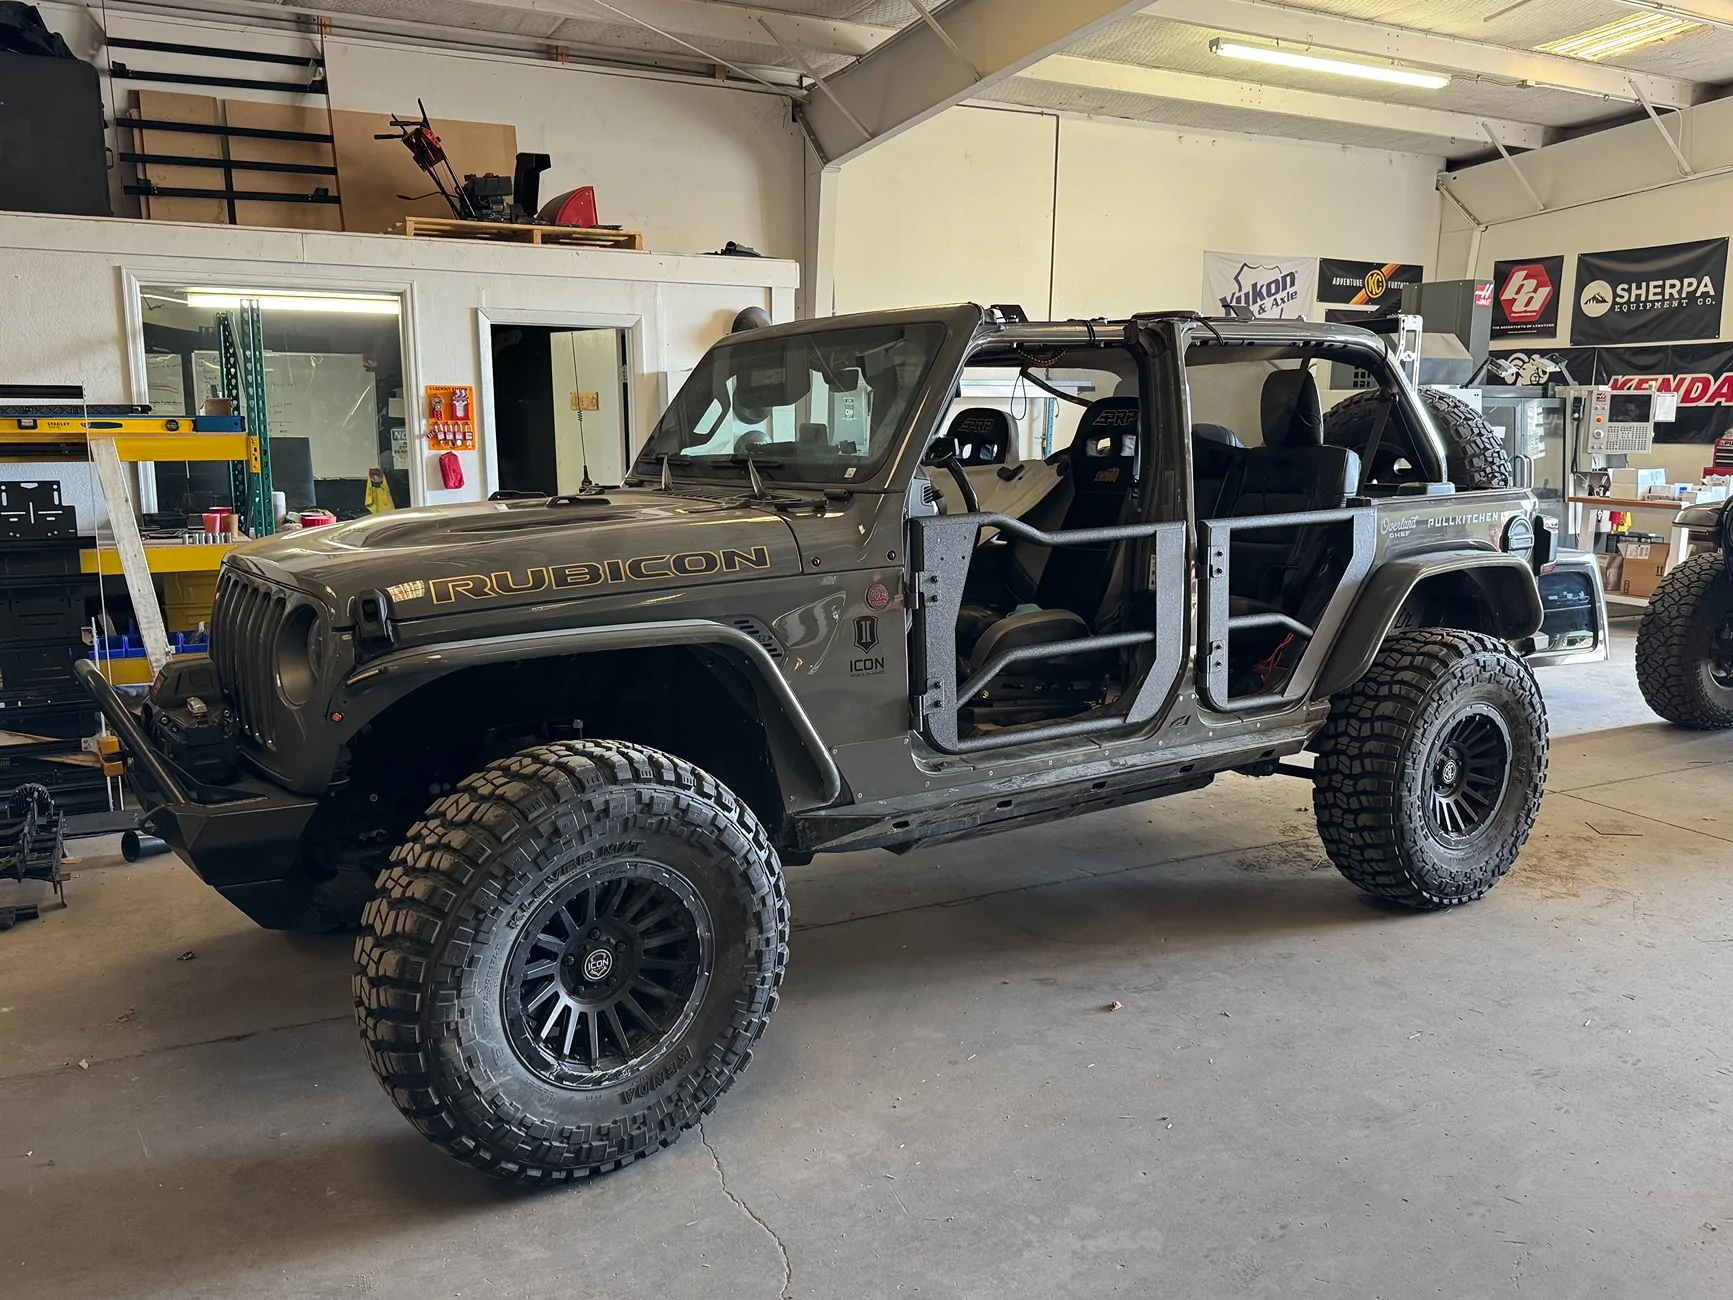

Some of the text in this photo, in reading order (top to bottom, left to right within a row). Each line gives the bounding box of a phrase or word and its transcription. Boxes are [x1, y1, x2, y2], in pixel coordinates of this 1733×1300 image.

[1218, 270, 1296, 316] Yukon
[1332, 272, 1409, 295] ADVENTURE KC FURTH
[1615, 275, 1715, 303] SHERPA
[1257, 289, 1298, 316] & Axle
[1614, 298, 1716, 312] EQUIPMENT CO.
[1608, 372, 1733, 408] KENDA
[1380, 511, 1500, 535] Overland PULLKITCHEN
[1389, 530, 1411, 539] CHEF
[430, 545, 771, 605] RUBICON
[849, 656, 885, 673] ICON
[588, 957, 609, 972] ICON
[621, 1044, 693, 1105] KENDA
